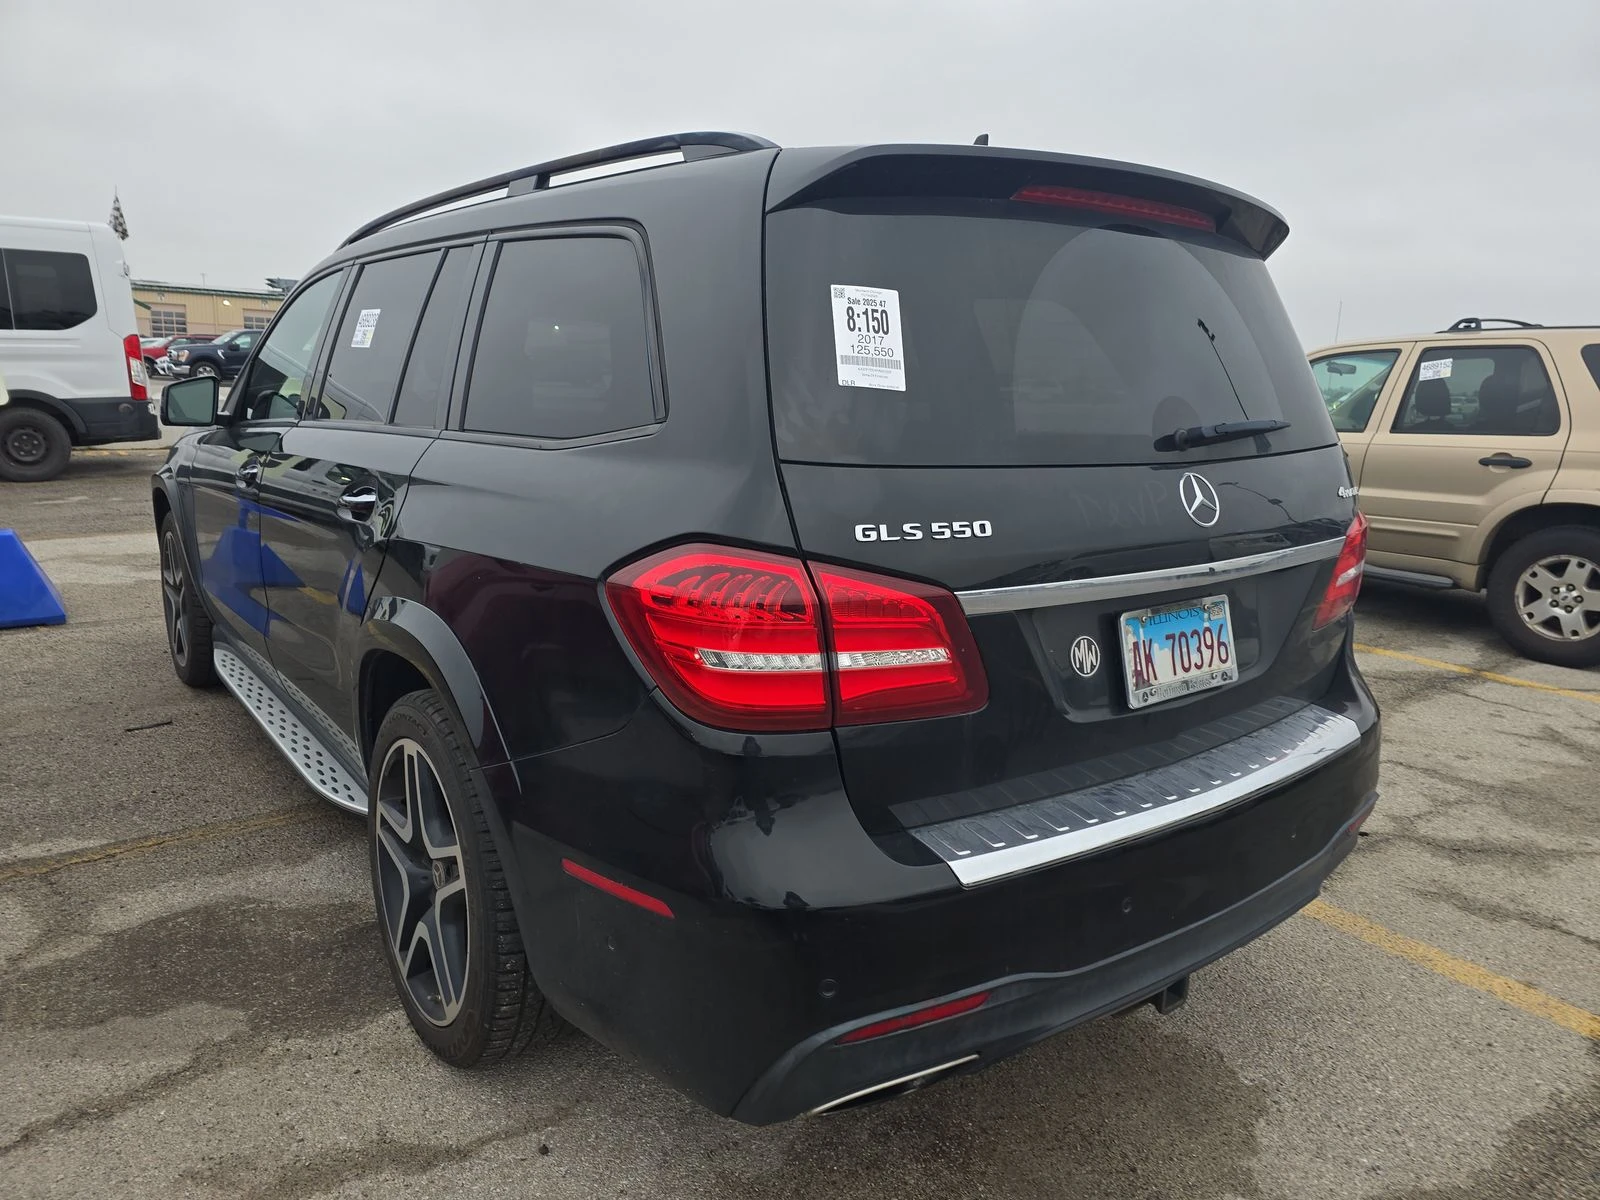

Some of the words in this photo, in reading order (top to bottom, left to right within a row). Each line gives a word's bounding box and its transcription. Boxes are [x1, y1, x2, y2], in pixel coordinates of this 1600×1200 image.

[847, 297, 861, 305] Sale
[863, 298, 877, 307] 2025
[879, 300, 886, 308] 47
[846, 306, 890, 335] 8:150
[857, 334, 884, 345] 2017
[850, 345, 894, 358] 125,550
[854, 523, 925, 542] GLS
[930, 520, 993, 540] 550
[1149, 607, 1201, 626] ILLINOIS
[1132, 638, 1158, 688] AK
[1165, 623, 1229, 676] 70396
